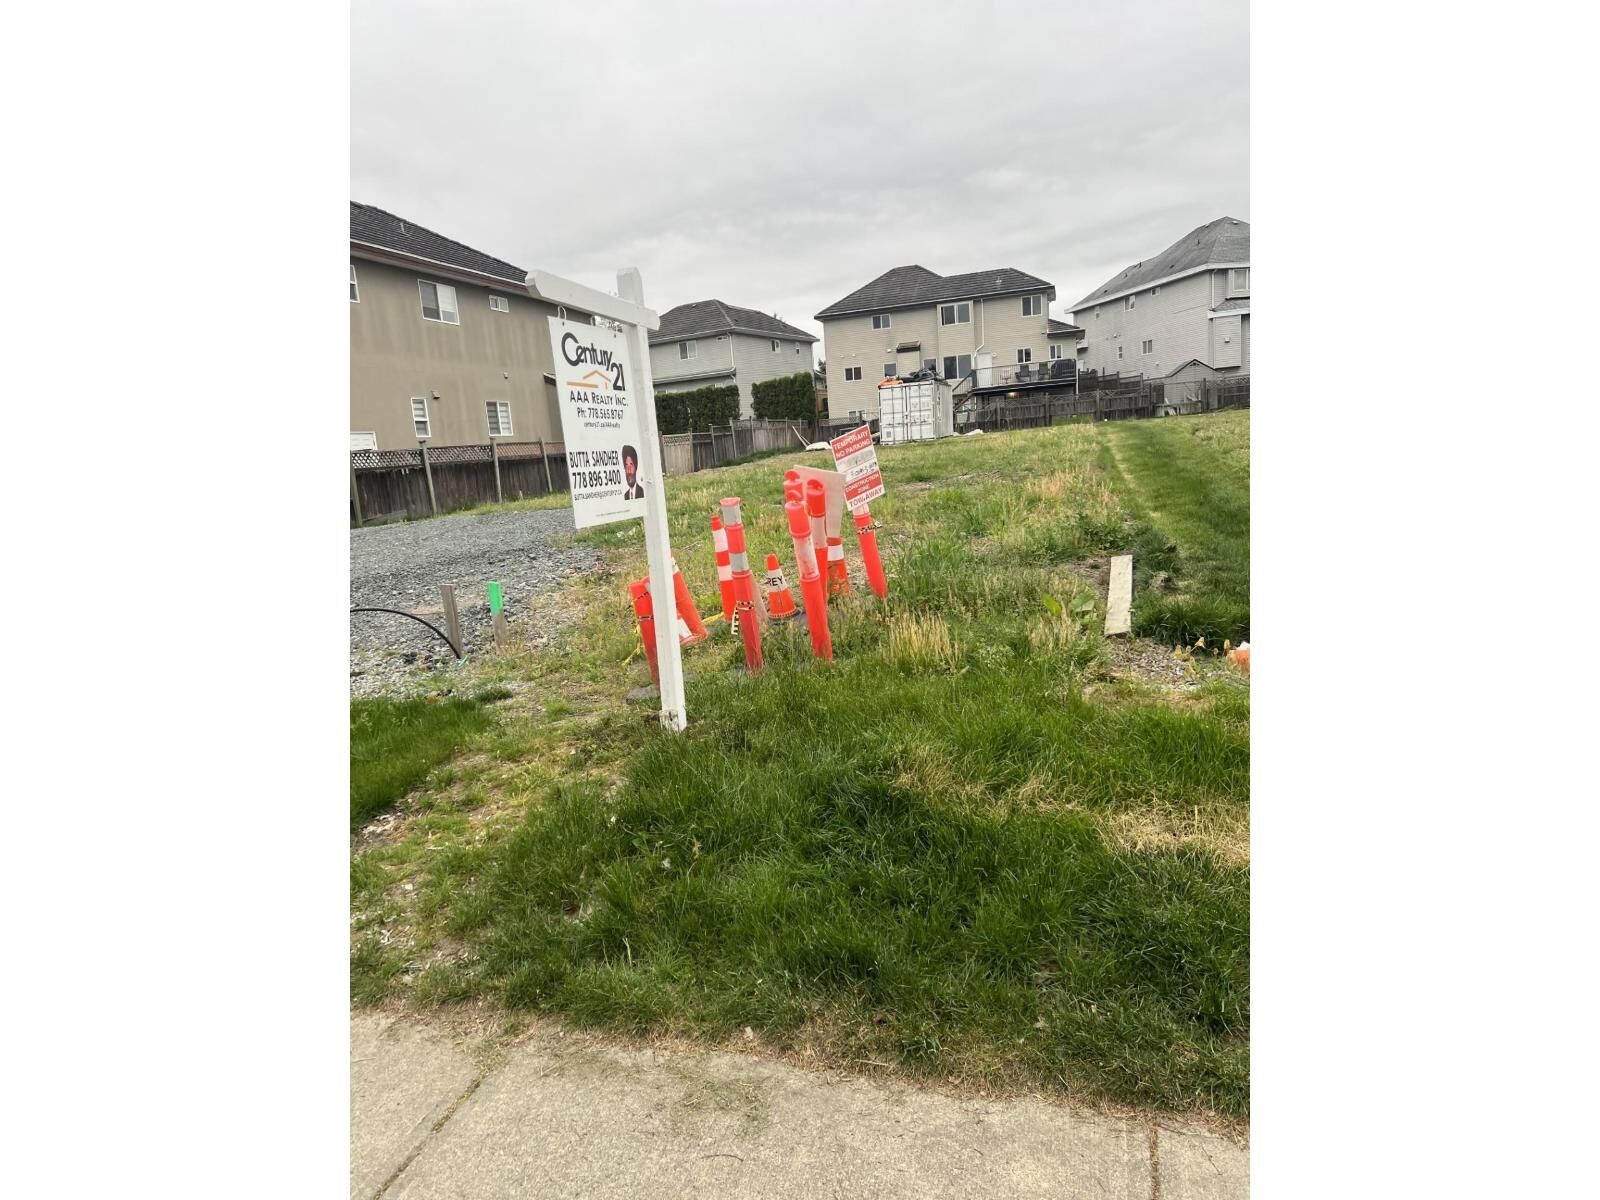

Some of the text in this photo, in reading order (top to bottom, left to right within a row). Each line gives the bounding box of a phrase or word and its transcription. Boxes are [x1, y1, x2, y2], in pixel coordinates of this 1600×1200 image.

[561, 332, 613, 371] Century
[610, 362, 626, 391] 21
[569, 390, 590, 403] AAA
[833, 430, 869, 450] TEMPORARY
[835, 438, 872, 458] NO PARKING
[569, 450, 620, 468] BUTTA SANDHER
[572, 469, 622, 489] 778 896 3400
[845, 473, 879, 493] CONSTRUCTION
